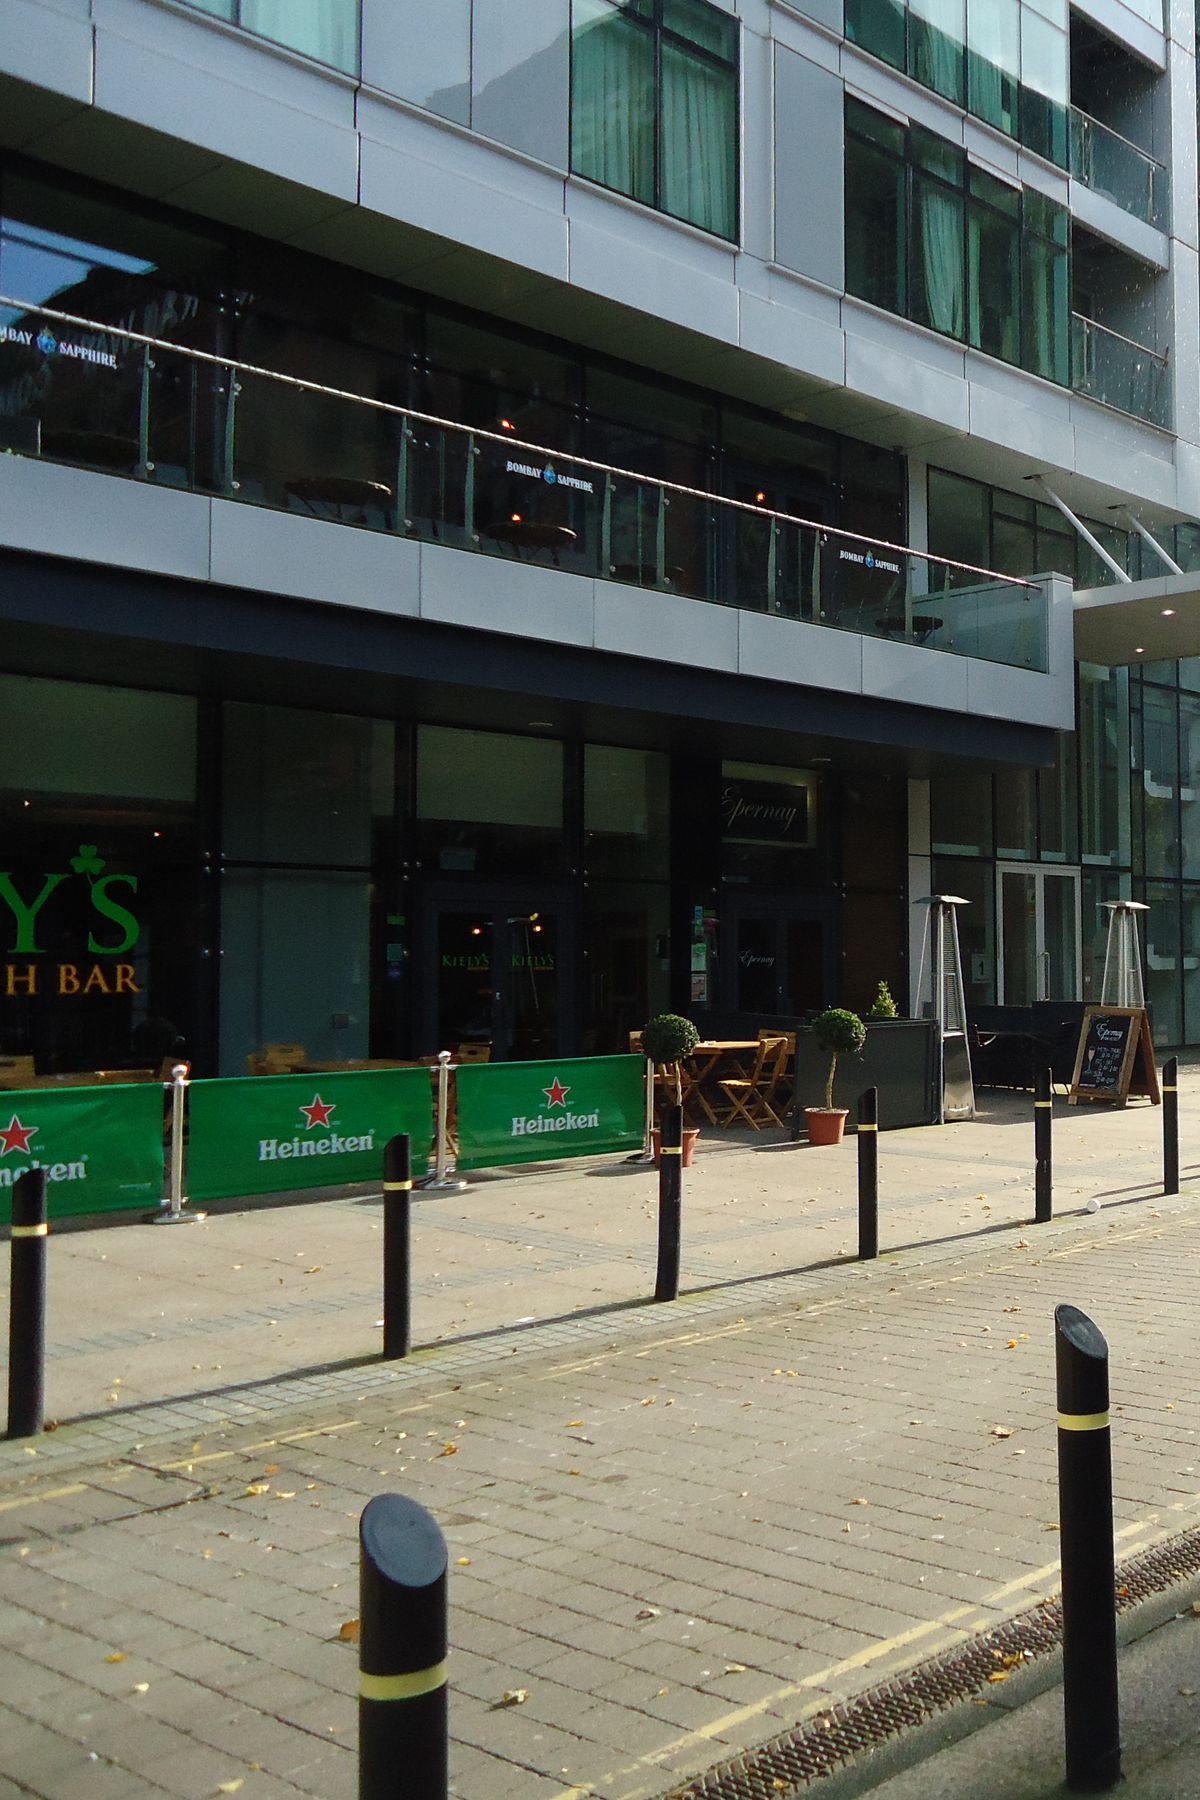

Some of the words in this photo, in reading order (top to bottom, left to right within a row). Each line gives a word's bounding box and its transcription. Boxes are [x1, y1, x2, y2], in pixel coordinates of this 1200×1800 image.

[59, 342, 118, 370] SAPPHIRE
[506, 460, 542, 479] BOMBAY
[557, 474, 594, 494] SAPPHIRE
[840, 549, 864, 564] BOMBAY
[875, 559, 900, 575] SAPPHIRE
[58, 964, 142, 994] BAR
[511, 1112, 599, 1136] Heineken
[259, 1133, 374, 1161] Heineken
